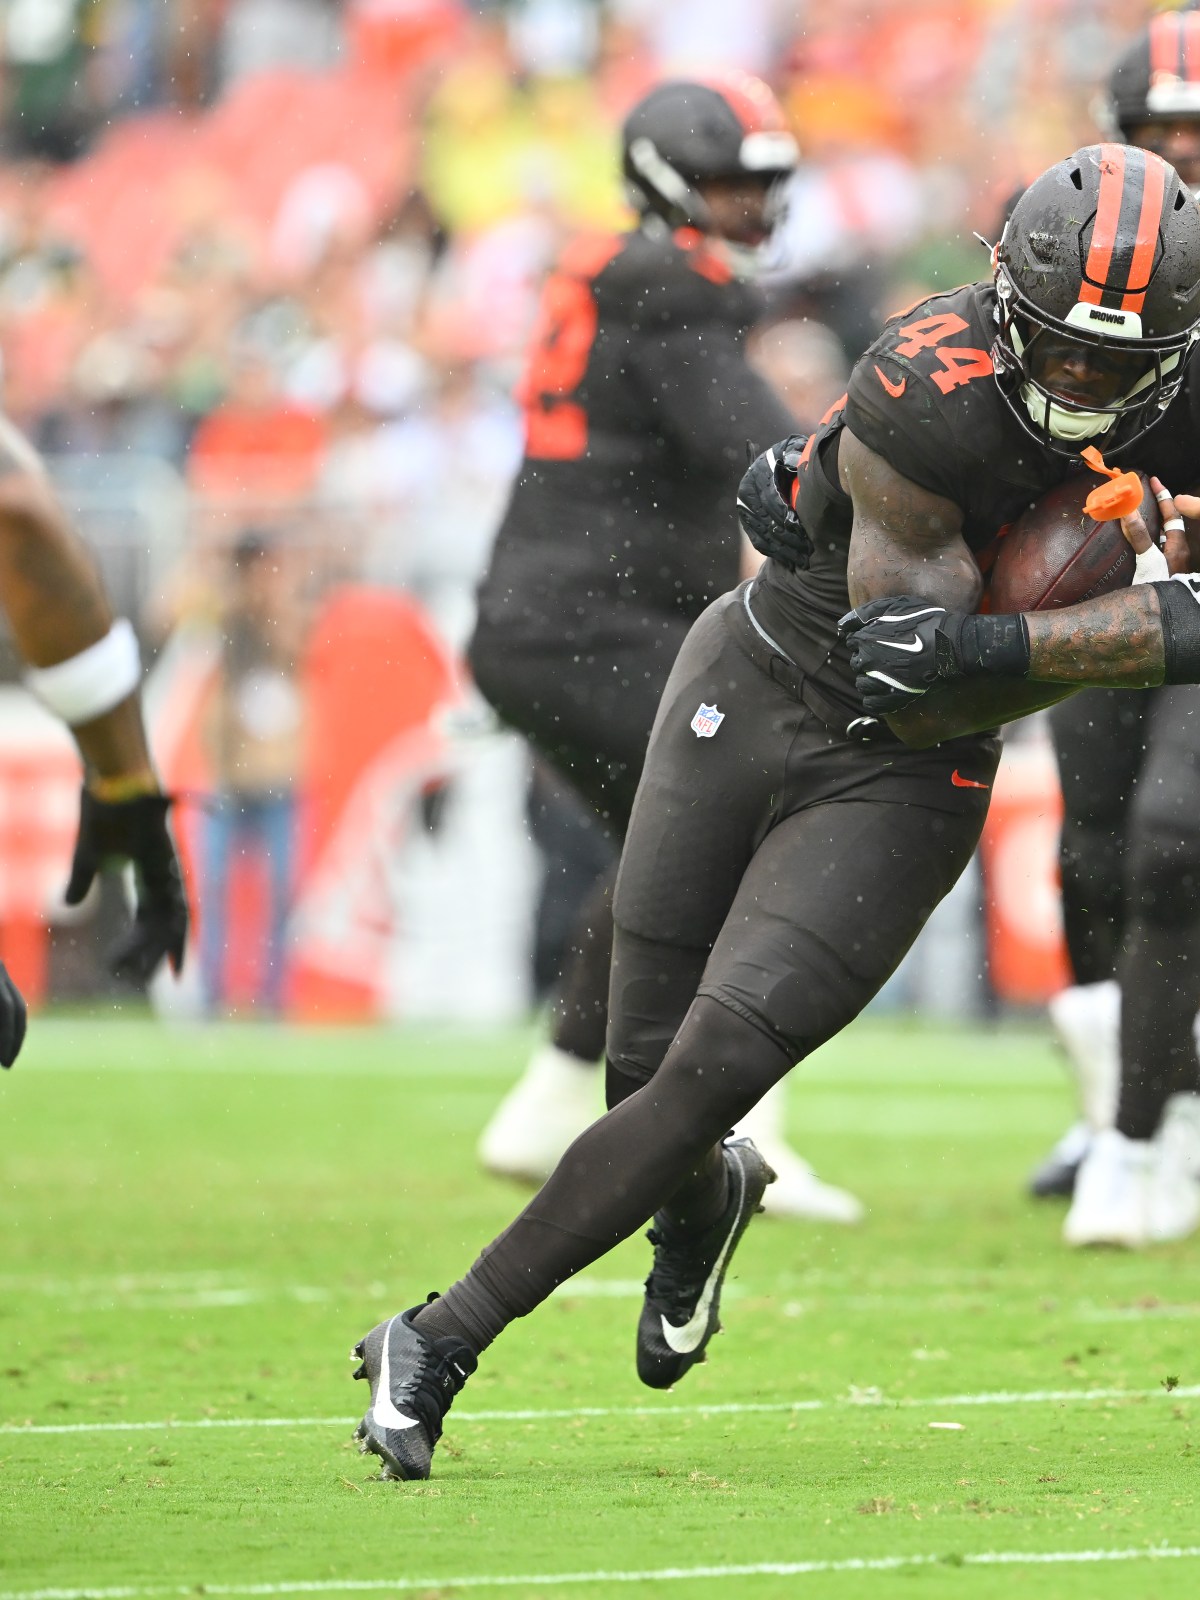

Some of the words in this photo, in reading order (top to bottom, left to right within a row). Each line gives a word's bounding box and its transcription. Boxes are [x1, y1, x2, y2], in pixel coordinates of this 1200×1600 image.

[1089, 309, 1126, 325] BROWNS
[894, 312, 994, 395] 44
[1095, 550, 1129, 589] FOOTBALL
[696, 717, 713, 733] NFL
